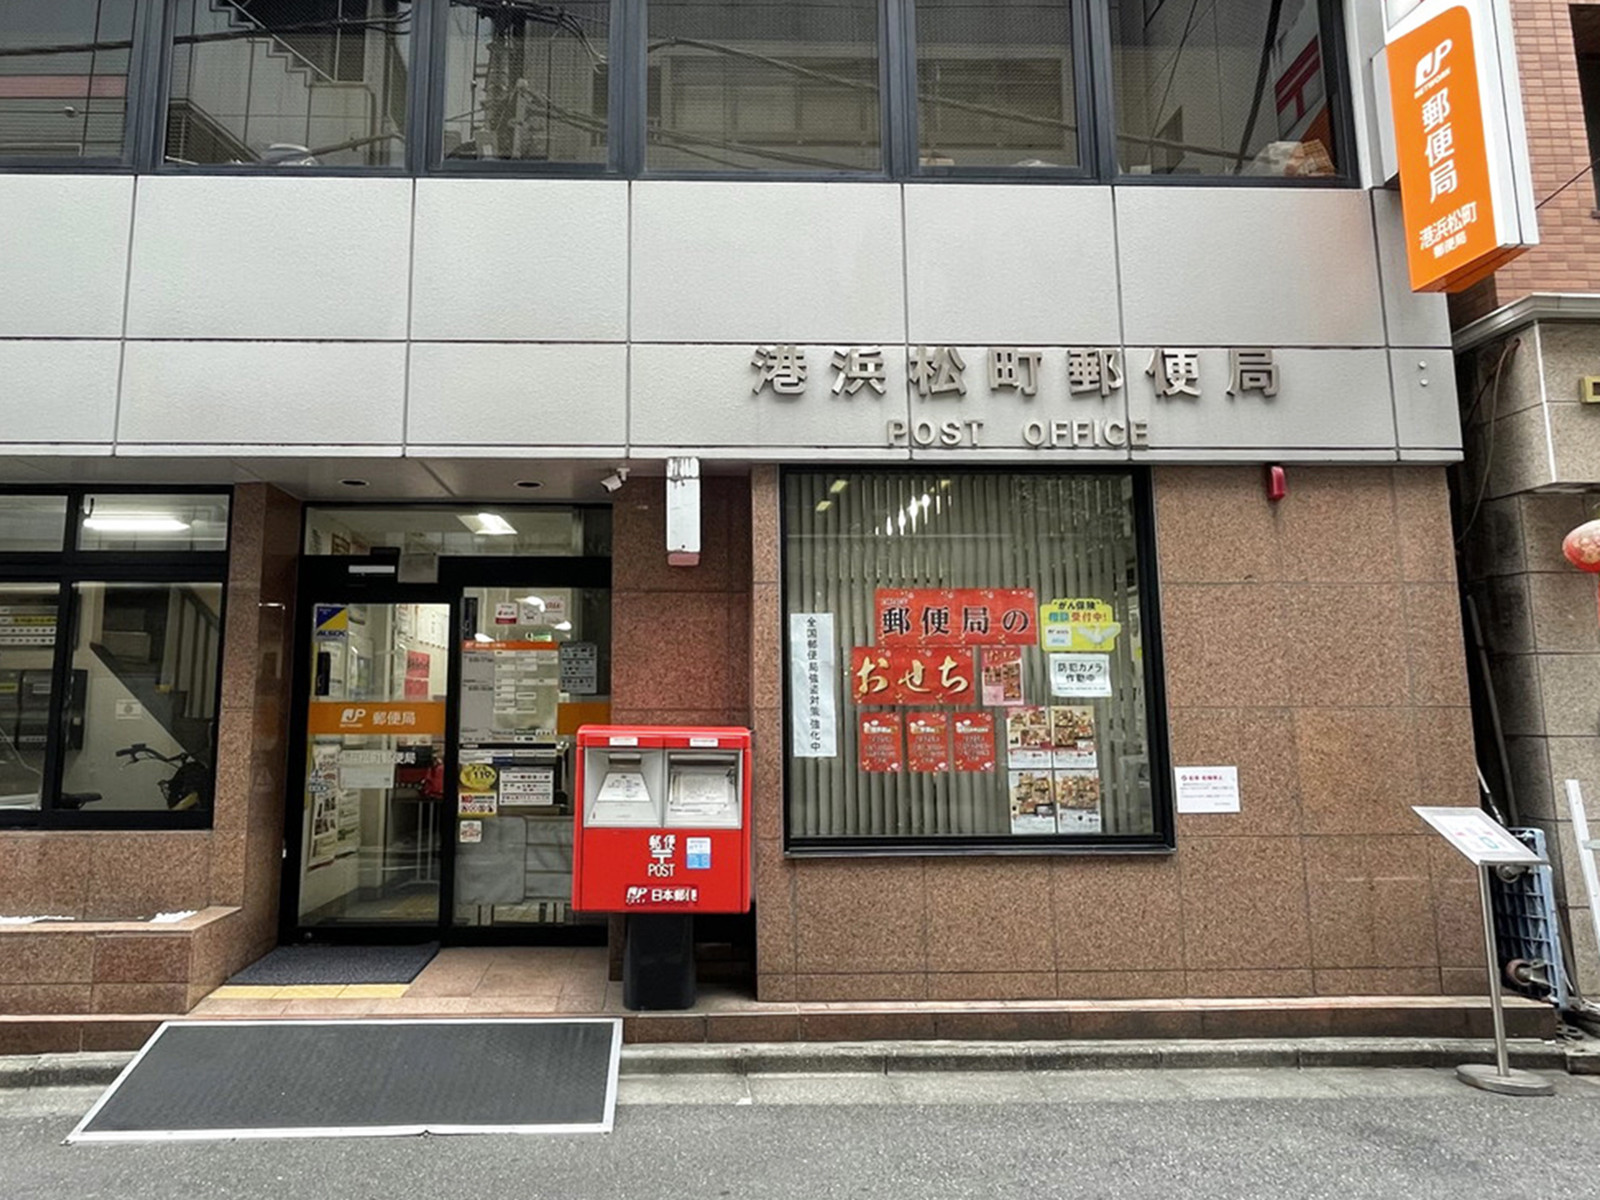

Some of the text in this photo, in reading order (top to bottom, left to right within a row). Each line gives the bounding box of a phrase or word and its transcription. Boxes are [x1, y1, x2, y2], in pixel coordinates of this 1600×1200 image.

[1421, 87, 1459, 204] 郵便局
[1419, 201, 1477, 251] 港浜松町
[751, 345, 1281, 398] 港浜松町郵便局
[887, 418, 1149, 450] POST OFFICE
[882, 606, 1029, 636] 郵便局の
[856, 655, 969, 695] おせち
[1058, 663, 1102, 673] 防犯カメラ
[373, 711, 416, 726] 郵便局
[648, 833, 677, 851] 郵便
[648, 863, 676, 878] POST
